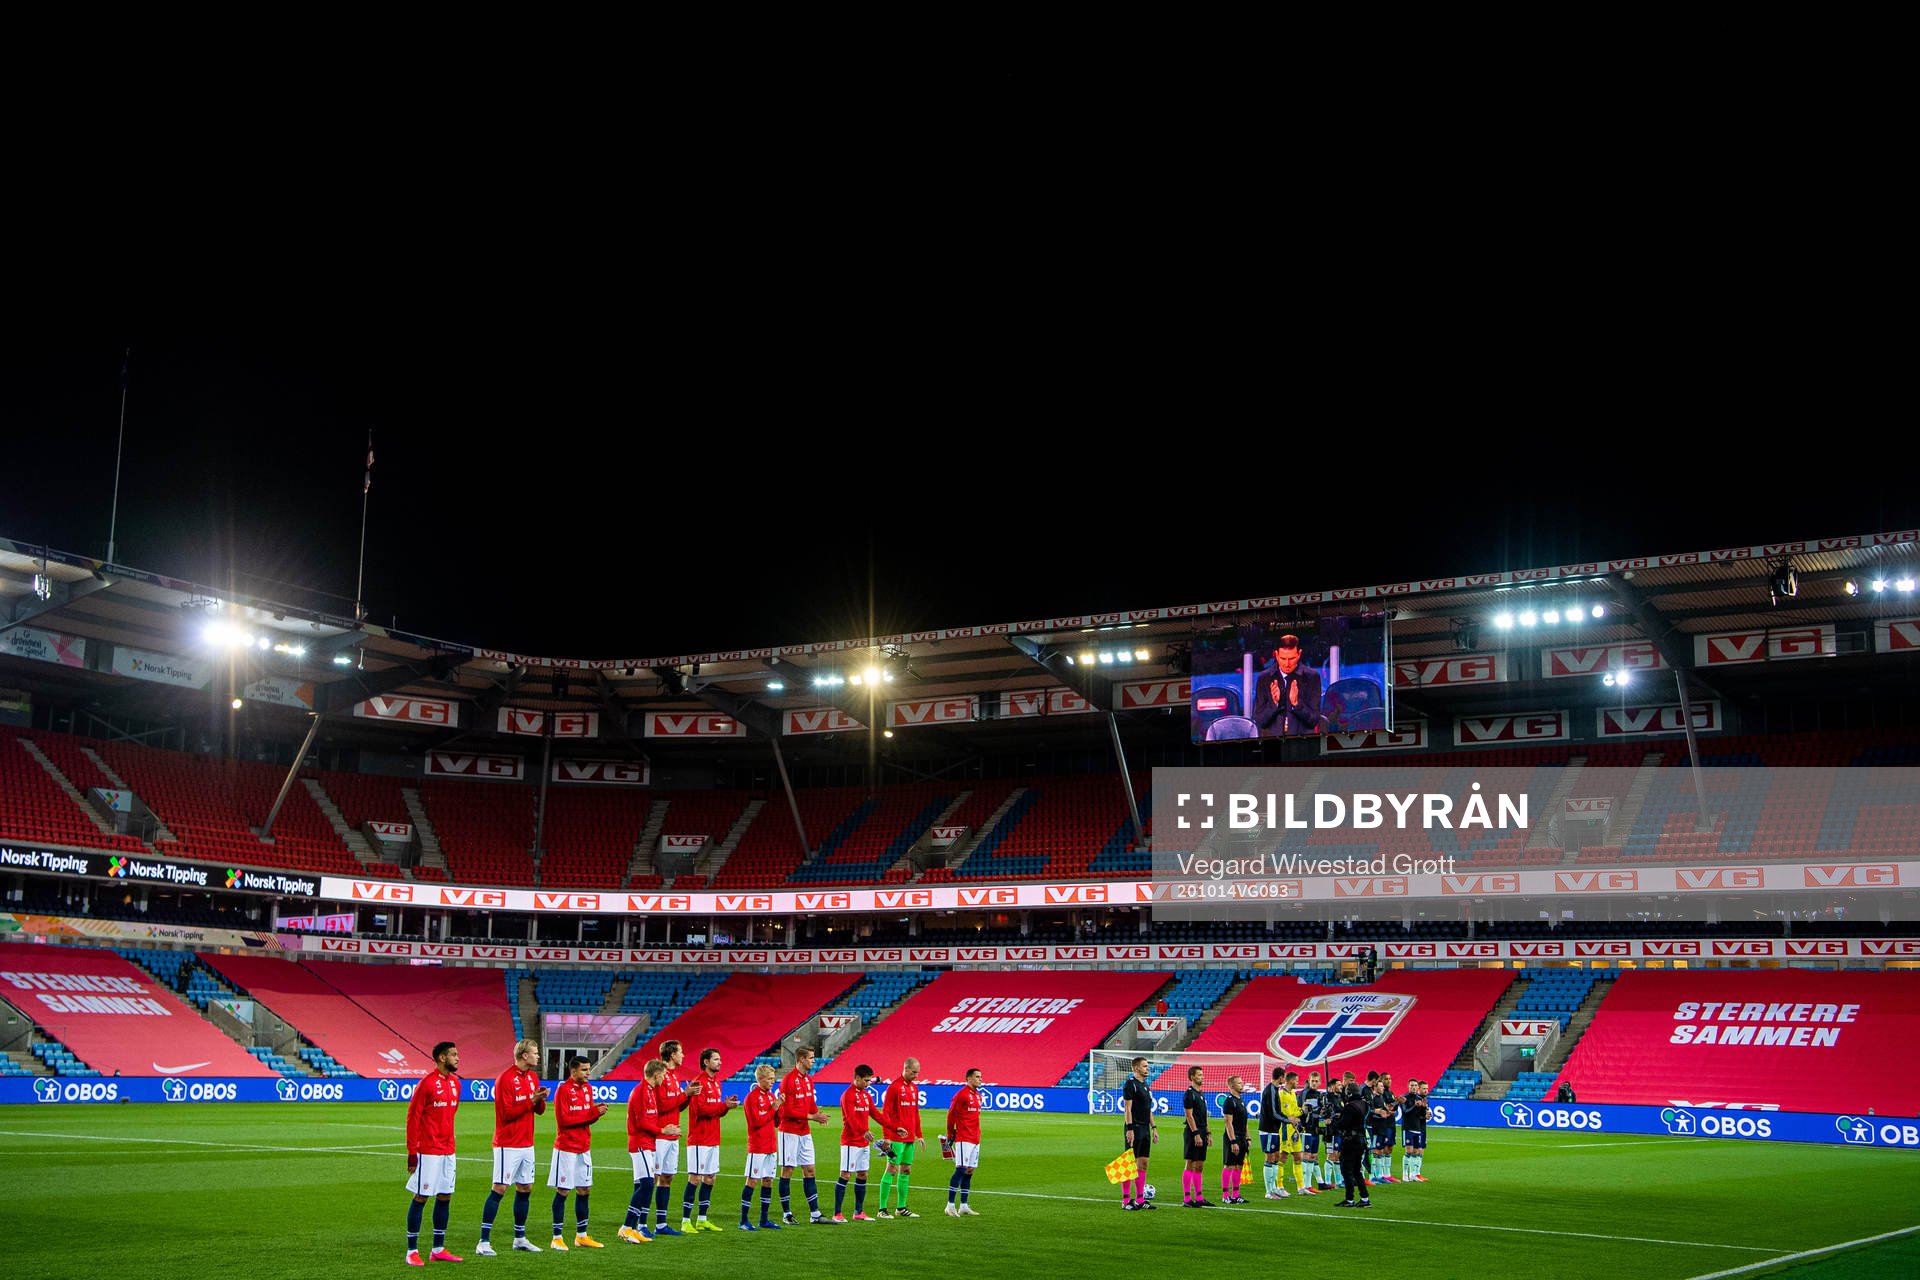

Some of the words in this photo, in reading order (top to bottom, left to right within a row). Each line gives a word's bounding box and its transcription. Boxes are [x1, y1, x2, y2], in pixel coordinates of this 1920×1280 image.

[1820, 537, 1859, 549] VG
[1876, 532, 1916, 544] VG
[1711, 548, 1750, 559] VG
[1765, 543, 1805, 554] VG
[1610, 559, 1645, 570] VG
[1660, 554, 1698, 564] VG
[1512, 570, 1549, 580] VG
[1560, 564, 1597, 575] VG
[1420, 579, 1455, 590] VG
[1466, 575, 1501, 585] VG
[1332, 590, 1365, 600] VG
[1376, 585, 1409, 595] VG
[1249, 598, 1280, 608] VG
[1290, 594, 1322, 604] VG
[1167, 606, 1198, 616] VG
[1207, 602, 1239, 612] VG
[1091, 614, 1120, 624] VG
[1130, 610, 1158, 620] VG
[1017, 621, 1045, 631] VG
[1053, 618, 1081, 627] VG
[947, 629, 973, 638] VG
[981, 625, 1010, 634] VG
[877, 636, 904, 645] VG
[911, 632, 937, 641] VG
[811, 643, 836, 652] VG
[845, 640, 870, 648] VG
[1709, 631, 1816, 661] VG
[481, 650, 506, 660] VG
[719, 652, 742, 661] VG
[748, 650, 772, 658] VG
[780, 646, 804, 655] VG
[515, 656, 541, 665] VG
[551, 659, 580, 669] VG
[589, 660, 616, 669] VG
[624, 659, 650, 668] VG
[656, 657, 680, 667] VG
[687, 655, 712, 664] VG
[1555, 644, 1655, 673] VG
[144, 662, 166, 677] Norsk
[165, 665, 192, 682] Tipping
[1398, 659, 1492, 685] VG
[1011, 692, 1085, 714] VG
[370, 696, 446, 723] VG
[896, 700, 969, 724] VG
[511, 711, 584, 733] VG
[655, 714, 734, 733] VG
[1605, 706, 1709, 732] VG
[1462, 715, 1557, 741] VG
[432, 754, 516, 776] VG
[559, 760, 642, 781] VG
[1567, 800, 1611, 811] VG
[371, 822, 408, 835] VG
[669, 835, 705, 847] VG
[1, 847, 40, 867] Norsk
[41, 852, 88, 875] Tipping
[129, 861, 164, 880] Norsk
[165, 865, 208, 886] Tipping
[1677, 868, 1763, 888] VG
[1806, 865, 1897, 885] VG
[244, 873, 276, 891] Norsk
[277, 876, 315, 896] Tipping
[1336, 878, 1407, 895] VG
[1443, 874, 1518, 893] VG
[1556, 871, 1637, 891] VG
[355, 882, 412, 902] VG
[442, 888, 504, 907] VG
[959, 887, 1017, 905] VG
[1046, 885, 1108, 903] VG
[536, 893, 598, 910] VG
[629, 895, 689, 911] VG
[717, 895, 772, 911] VG
[797, 893, 849, 909] VG
[875, 890, 931, 907] VG
[158, 928, 178, 938] Norsk
[178, 930, 204, 941] Tipping
[324, 939, 357, 951] VG
[371, 942, 411, 954] VG
[421, 945, 462, 957] VG
[1270, 945, 1315, 957] VG
[1386, 944, 1434, 956] VG
[1448, 944, 1497, 956] VG
[1511, 943, 1563, 956] VG
[1576, 942, 1629, 955] VG
[1644, 942, 1700, 955] VG
[1714, 941, 1771, 955] VG
[1786, 941, 1846, 955] VG
[1861, 941, 1920, 954] VG
[474, 947, 515, 958] VG
[527, 949, 568, 960] VG
[580, 950, 621, 961] VG
[632, 951, 672, 962] VG
[682, 951, 720, 962] VG
[729, 952, 766, 962] VG
[777, 951, 811, 962] VG
[820, 951, 855, 961] VG
[865, 950, 901, 961] VG
[911, 949, 948, 960] VG
[958, 949, 997, 960] VG
[1006, 948, 1045, 959] VG
[1055, 947, 1096, 959] VG
[1108, 946, 1149, 959] VG
[1160, 946, 1203, 958] VG
[1214, 945, 1259, 958] VG
[0, 971, 150, 994] STERKERE
[36, 994, 172, 1016] SAMMEN
[1342, 995, 1380, 1003] NORGE
[949, 997, 1084, 1015] STERKERE
[1673, 1002, 1861, 1023] STERKERE
[932, 1017, 1055, 1034] SAMMEN
[1669, 1025, 1841, 1047] SAMMEN
[64, 1083, 118, 1101] OBOS
[190, 1083, 237, 1100] OBOS
[301, 1083, 344, 1100] OBOS
[592, 1085, 618, 1101] BOS
[995, 1092, 1044, 1109] OBOS
[1538, 1109, 1602, 1129] OBOS
[1701, 1116, 1772, 1137] OBOS
